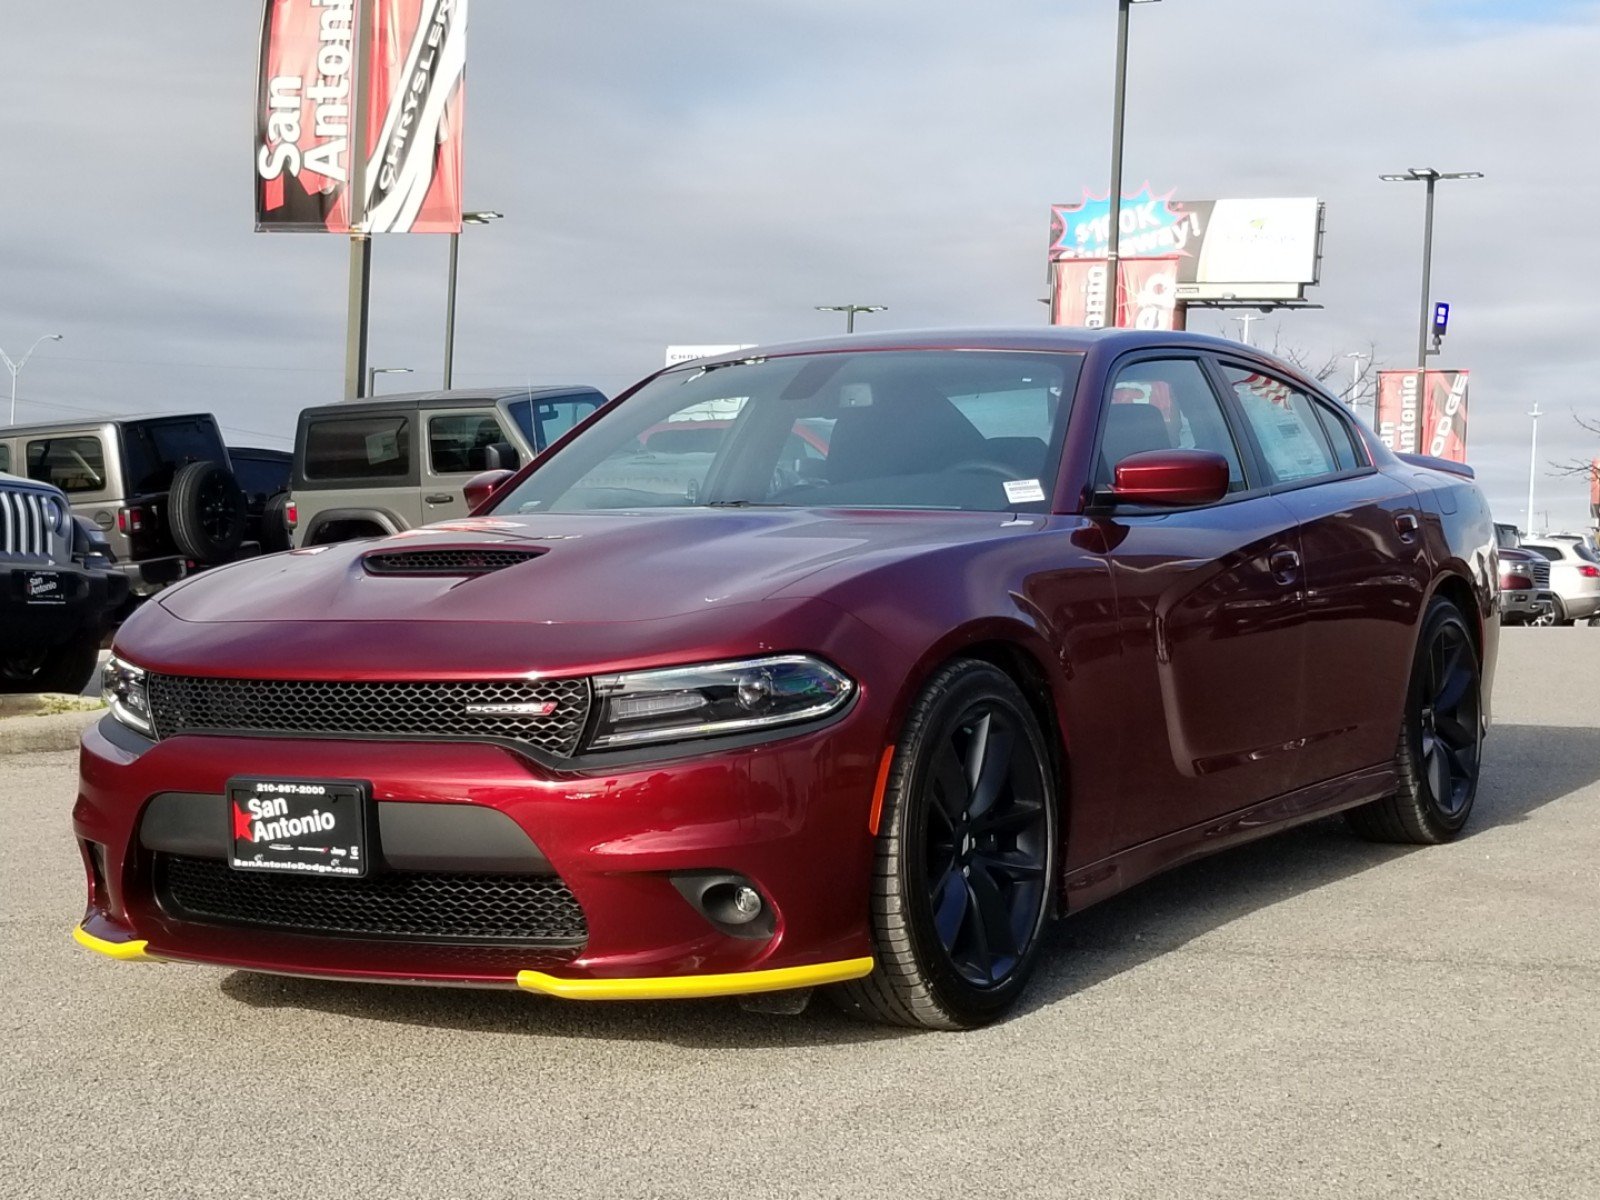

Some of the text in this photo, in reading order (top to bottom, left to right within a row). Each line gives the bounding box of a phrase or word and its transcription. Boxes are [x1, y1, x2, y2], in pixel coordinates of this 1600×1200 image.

[379, 0, 454, 190] CHRYSLER
[259, 75, 302, 180] San
[1380, 421, 1395, 452] an
[248, 797, 289, 820] San
[253, 809, 335, 843] Antonio
